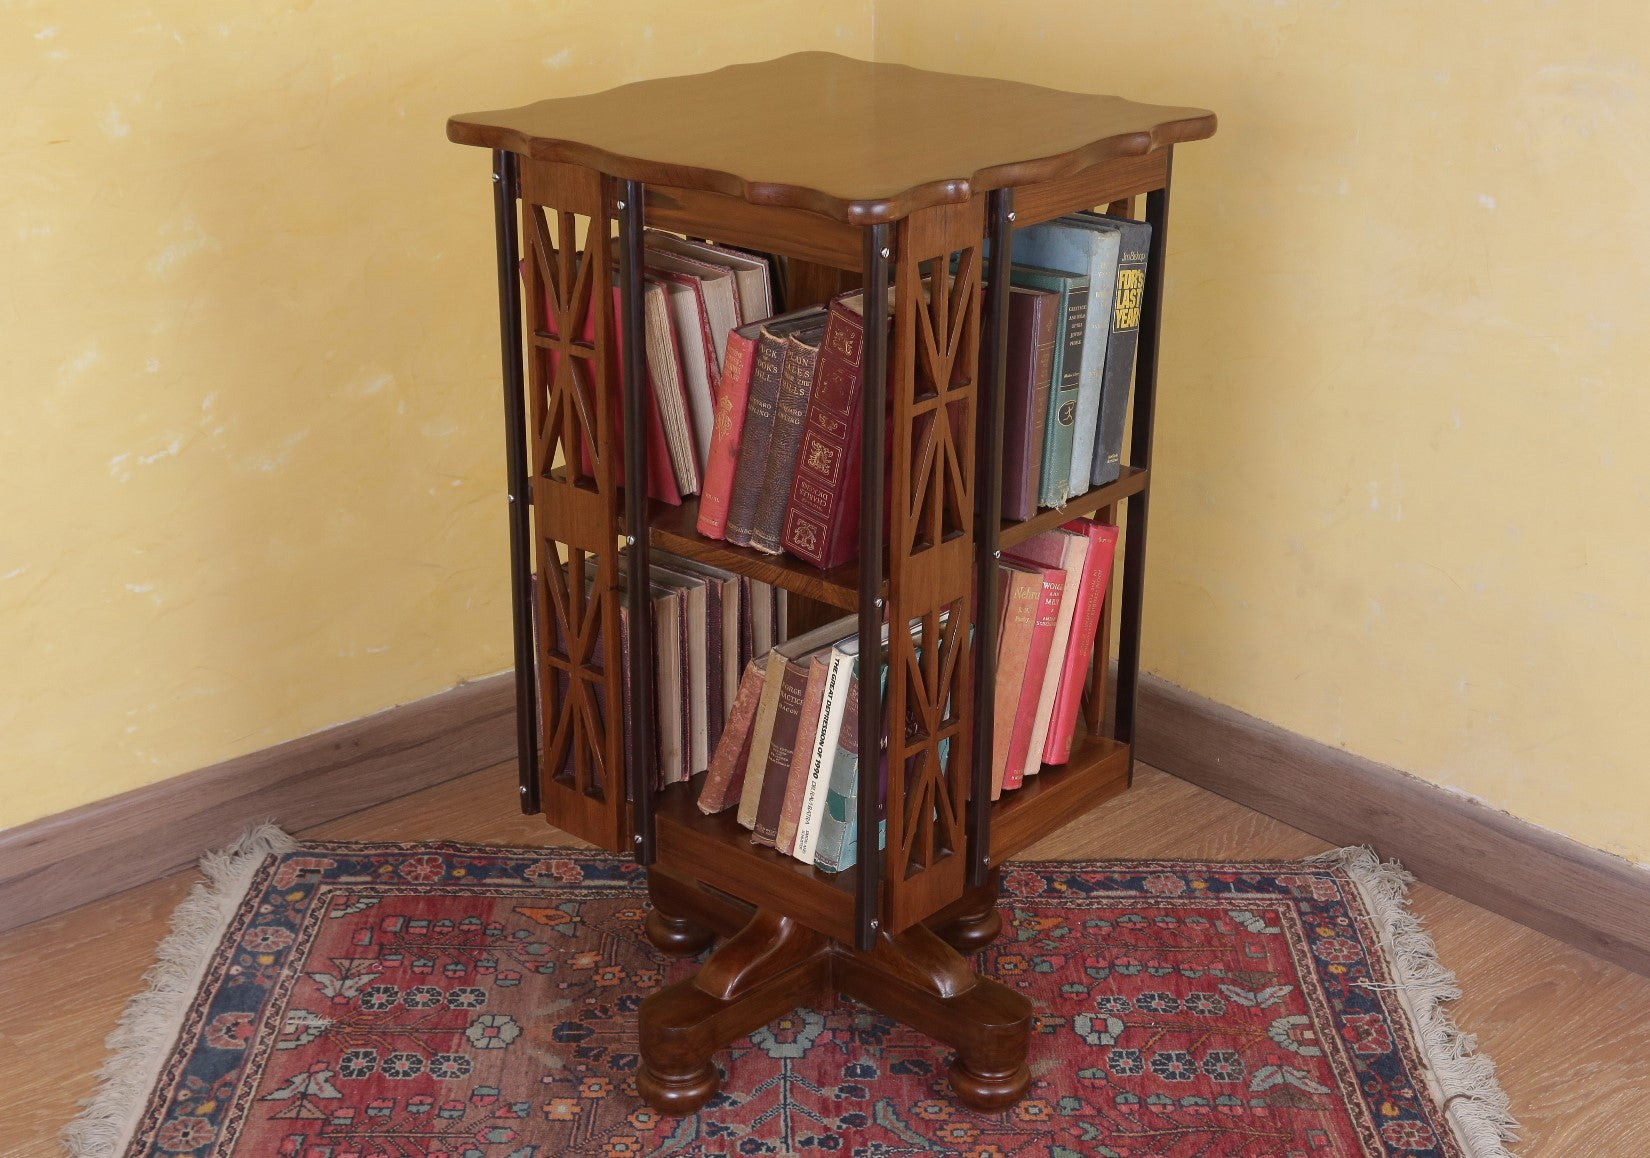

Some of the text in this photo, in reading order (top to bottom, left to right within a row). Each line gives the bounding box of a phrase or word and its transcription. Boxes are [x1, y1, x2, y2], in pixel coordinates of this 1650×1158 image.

[1116, 288, 1142, 310] LAST
[1115, 307, 1140, 329] YEAR
[759, 343, 778, 359] UCK
[828, 673, 838, 700] GREAT
[819, 699, 833, 748] DEPRESSION
[816, 747, 824, 759] OF
[813, 759, 822, 780] 1990
